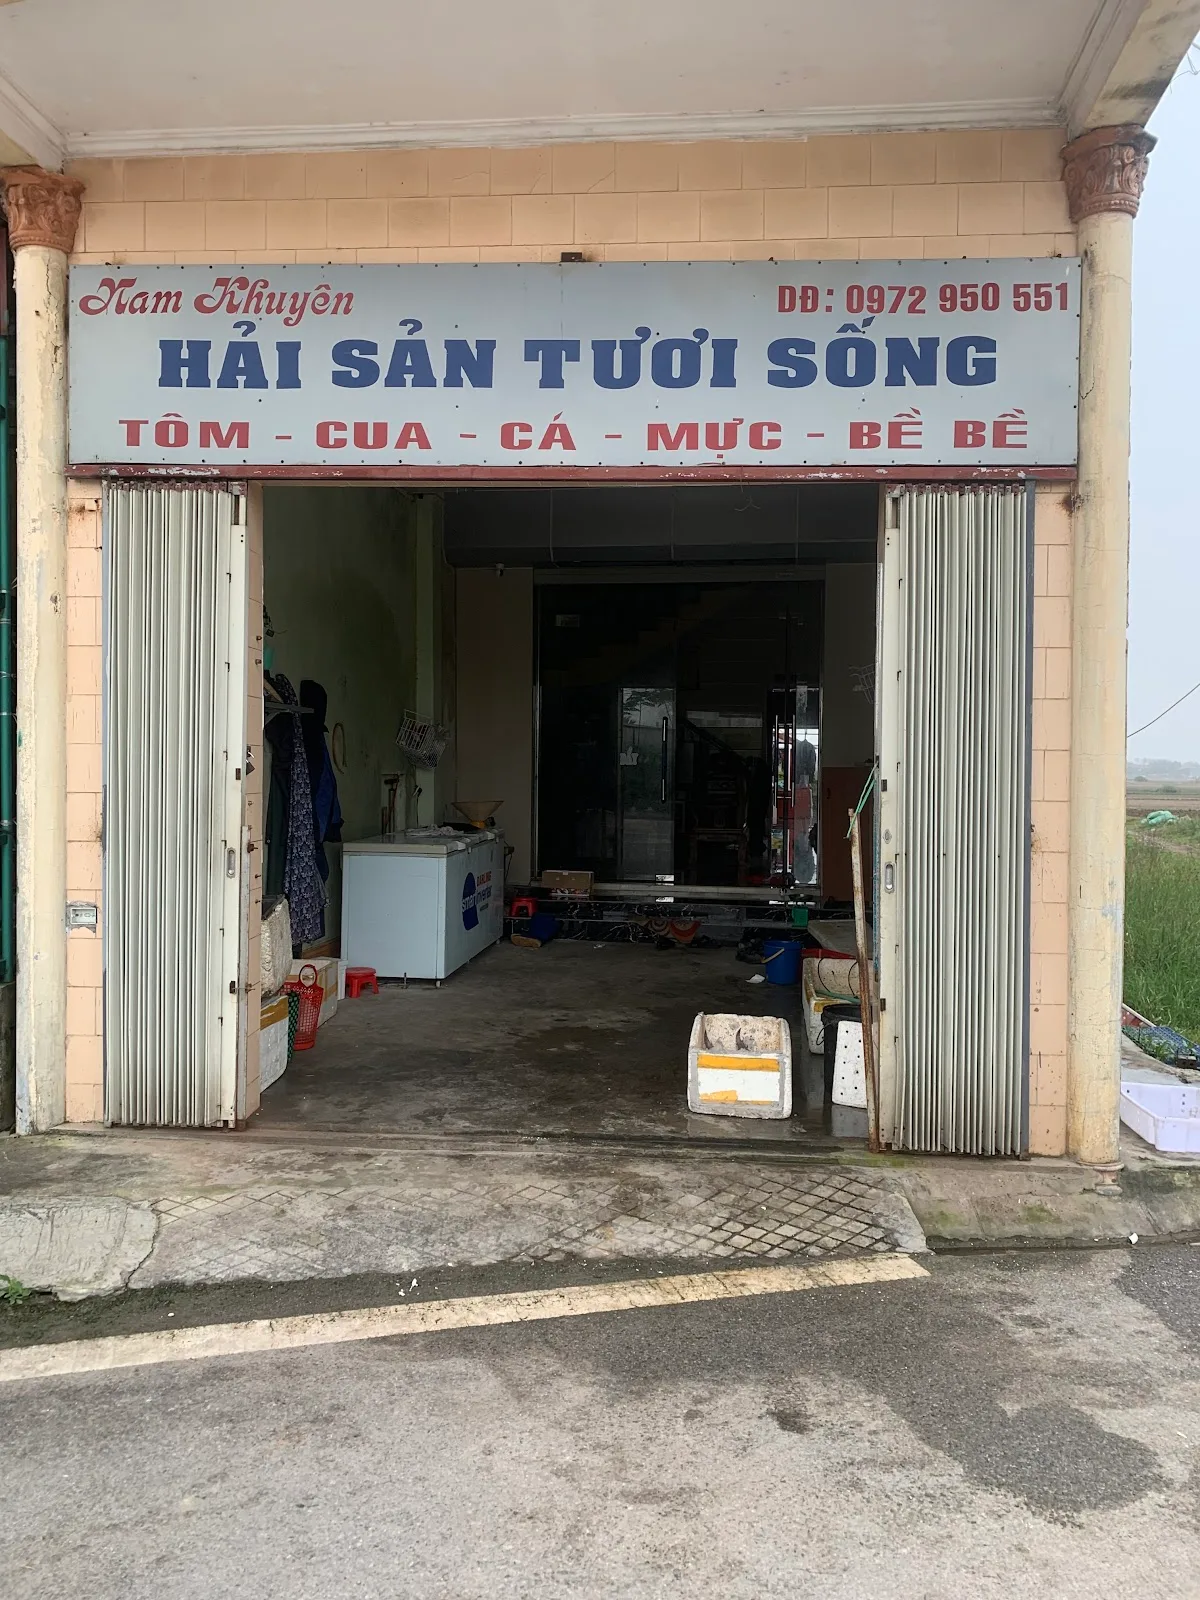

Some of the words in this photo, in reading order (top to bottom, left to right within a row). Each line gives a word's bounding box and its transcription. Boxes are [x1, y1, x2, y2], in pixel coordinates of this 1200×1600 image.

[79, 276, 183, 316] Nam
[194, 275, 354, 327] Khuyên
[777, 284, 834, 313] DĐ:
[845, 284, 927, 315] 0972
[939, 282, 1001, 313] 950
[1013, 281, 1069, 312] 551
[158, 318, 302, 389] HẢI
[331, 318, 497, 389] SẢN
[523, 326, 739, 389] TƯƠI
[766, 315, 998, 388] SỐNG
[118, 412, 250, 449] TÔM
[315, 420, 433, 450] CUA
[500, 410, 577, 451] CÁ
[646, 417, 783, 459] MỰC
[848, 406, 924, 450] BỀ
[952, 407, 1029, 449] BỀ
